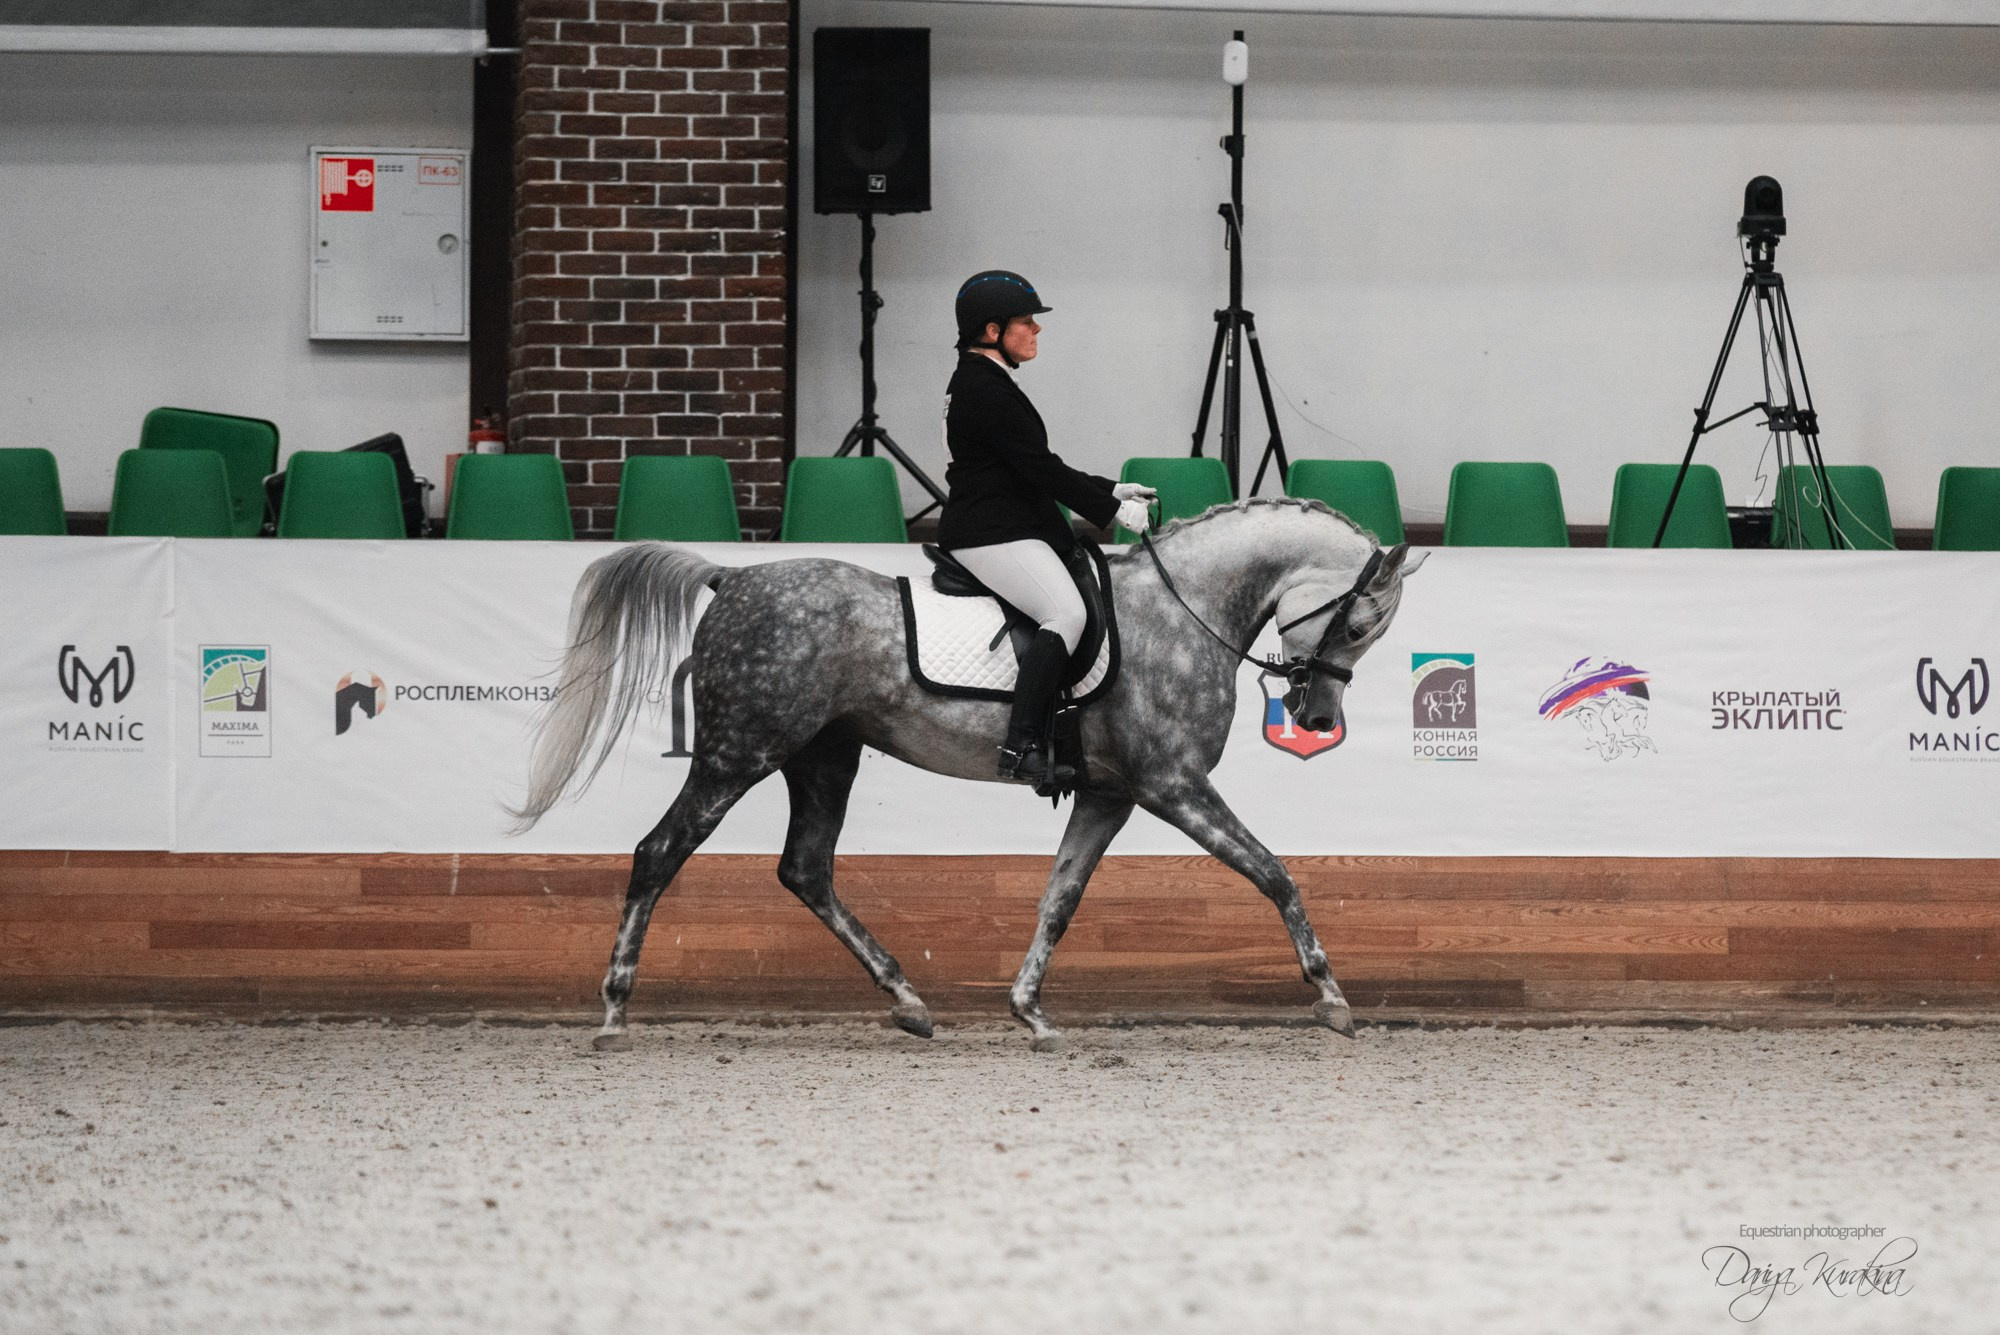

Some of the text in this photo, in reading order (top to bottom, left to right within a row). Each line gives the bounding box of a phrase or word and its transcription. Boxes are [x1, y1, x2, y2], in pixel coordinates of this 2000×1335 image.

[1712, 688, 1840, 707] КРЫЛАТЫЙ
[48, 714, 144, 742] MANÍC
[211, 722, 259, 731] MAXIMA
[1413, 730, 1477, 742] КОННАЯ
[1909, 725, 2000, 752] MANÍC
[1413, 745, 1478, 757] РОССИЯ
